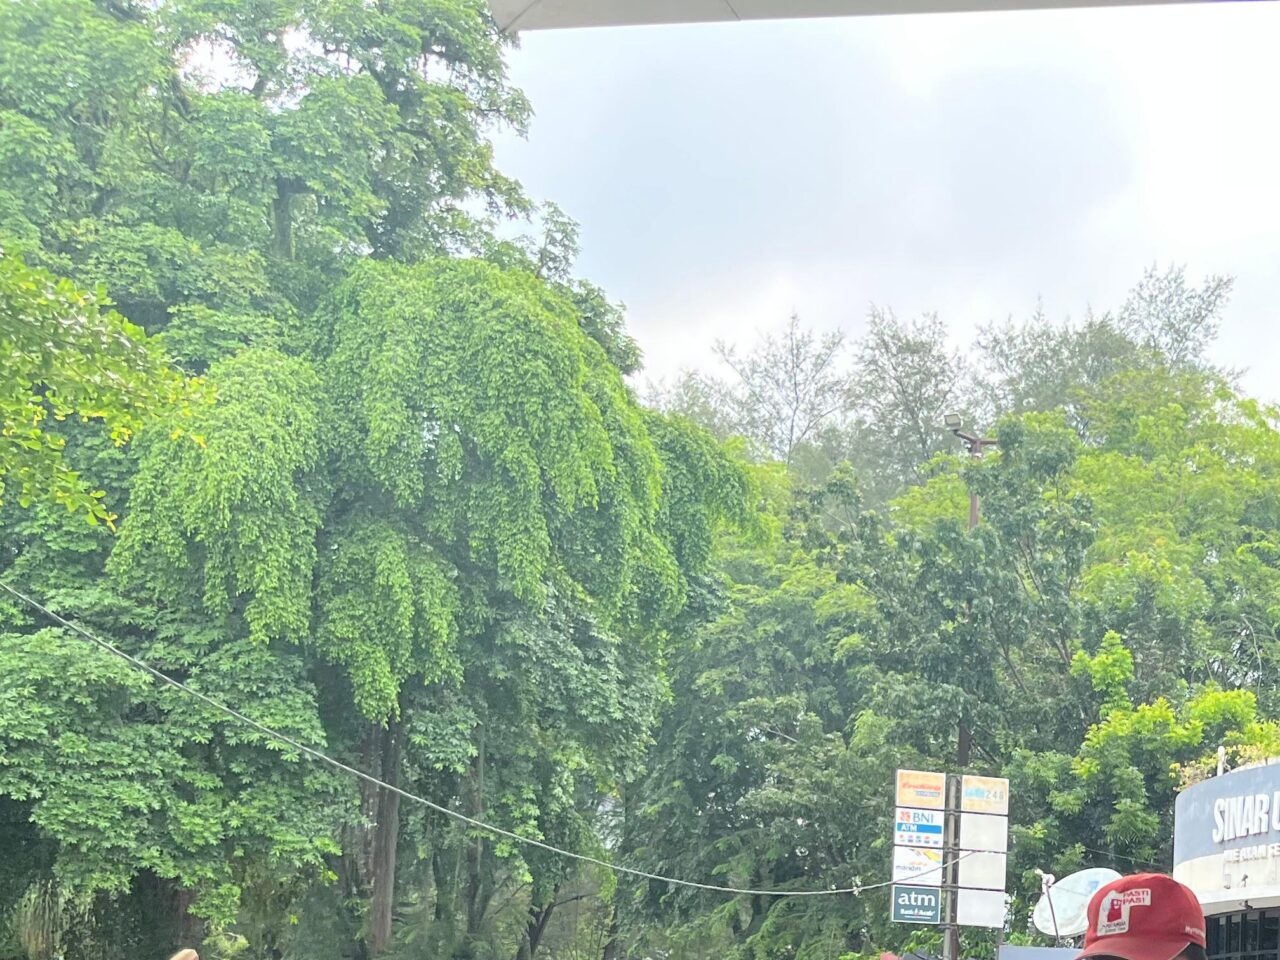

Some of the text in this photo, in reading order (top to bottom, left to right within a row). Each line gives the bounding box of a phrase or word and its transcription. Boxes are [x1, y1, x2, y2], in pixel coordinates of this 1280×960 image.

[913, 812, 934, 824] BNI
[1212, 793, 1270, 843] SINAR
[901, 823, 918, 832] ATM
[897, 891, 936, 907] atm
[1123, 889, 1149, 898] PASTI
